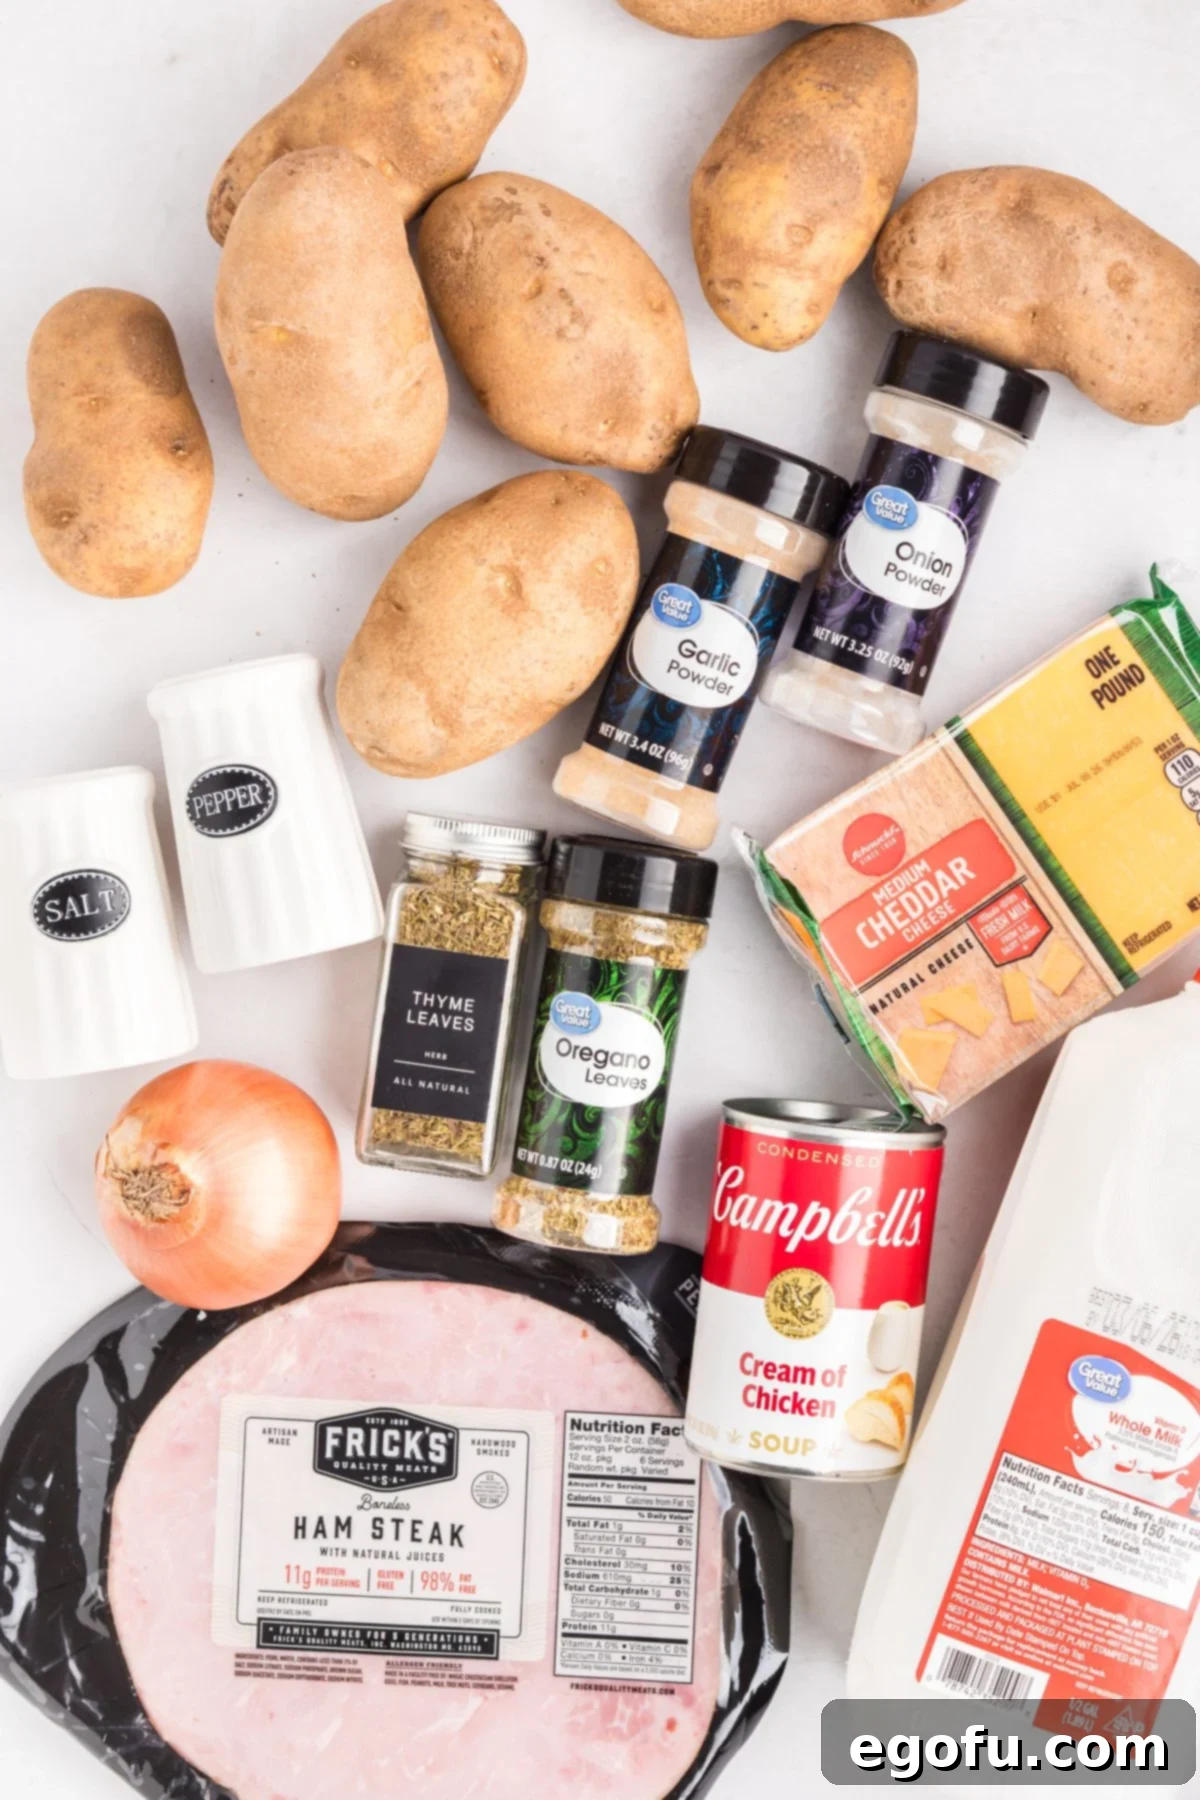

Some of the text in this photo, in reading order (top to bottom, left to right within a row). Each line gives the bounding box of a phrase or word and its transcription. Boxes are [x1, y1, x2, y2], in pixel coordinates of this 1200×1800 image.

[871, 492, 909, 515] Great
[876, 506, 905, 524] Value
[896, 541, 953, 578] Onion
[884, 562, 946, 597] Powder
[658, 590, 693, 613] Great
[662, 604, 690, 622] Value
[678, 639, 741, 677] Garlic
[813, 626, 914, 675] NET WT 3.25 OZ (92g)
[1085, 645, 1120, 679] ONE
[667, 659, 733, 696] Powder
[1091, 663, 1145, 710] POUND
[599, 722, 694, 771] NET WT 3.4 OZ (96g)
[1154, 742, 1167, 755] PER
[1159, 742, 1185, 761] SERVING
[1171, 754, 1194, 776] 110
[193, 783, 263, 818] PEPPER
[872, 859, 931, 906] MEDIUM
[44, 889, 114, 922] SALT
[856, 857, 976, 949] CHEDDAR
[902, 900, 956, 943] CHEESE
[980, 913, 1010, 939] FRESH
[1008, 899, 1032, 921] MILK
[869, 938, 974, 1015] NATURAL CHEESE
[412, 990, 475, 1013] THYME
[556, 999, 591, 1018] Great
[406, 1010, 475, 1032] LEAVES
[561, 1012, 590, 1029] Value
[424, 1050, 448, 1060] HERB
[556, 1037, 650, 1070] Oregano
[393, 1076, 471, 1095] ALL NATURAL
[585, 1069, 648, 1091] Leaves
[517, 1146, 602, 1179] NET WT 0.87 OZ (24g)
[758, 1142, 881, 1169] CONDENSED
[712, 1162, 926, 1252] Campbell's
[739, 1352, 847, 1388] Cream of
[1078, 1361, 1122, 1388] Great
[1085, 1379, 1118, 1397] Value
[742, 1384, 836, 1418] Chicken
[262, 1427, 298, 1436] ARTISAN
[570, 1418, 644, 1434] Nutrition
[1109, 1411, 1181, 1446] Whole Milk
[268, 1438, 291, 1446] MADE
[324, 1426, 447, 1464] FRICK'S
[471, 1438, 516, 1448] HARDWOOD
[569, 1433, 622, 1442] Serving Size
[748, 1431, 816, 1455] SOUP
[477, 1448, 510, 1457] SMOKED
[568, 1443, 665, 1455] Servings Per Container
[333, 1461, 438, 1474] QUALITY MEATS
[568, 1462, 668, 1476] Random Varied
[596, 1455, 612, 1463] pkg
[648, 1457, 684, 1468] Servings
[617, 1483, 648, 1491] Serving
[1002, 1457, 1178, 1529] Nutrition Facts Serv. size:
[357, 1493, 411, 1511] Boneless
[567, 1494, 602, 1502] Calories
[566, 1519, 609, 1529] Total Fat
[983, 1514, 1008, 1529] Protein
[1022, 1506, 1049, 1522] Sodium
[1102, 1535, 1121, 1548] Total
[1101, 1510, 1138, 1530] Calories
[293, 1516, 465, 1548] HAM STEAK
[573, 1532, 616, 1542] Saturated
[320, 1547, 445, 1562] WITH NATURAL JUICES
[564, 1558, 621, 1568] Cholesterol
[285, 1564, 311, 1589] 11g
[316, 1567, 345, 1575] PROTEIN
[377, 1570, 404, 1579] GLUTEN
[459, 1574, 472, 1582] FAT
[564, 1570, 600, 1579] Sodium
[964, 1559, 1065, 1602] DISTRIBUTED Walmart
[316, 1578, 360, 1588] PER SERVING
[377, 1581, 395, 1590] FREE
[420, 1571, 455, 1592] 98%
[459, 1585, 476, 1594] FREE
[564, 1583, 649, 1595] Total Carbohydrate
[278, 1598, 328, 1606] REFRIGERATED
[571, 1596, 601, 1606] Dietary
[570, 1609, 600, 1619] Sugars
[279, 1626, 478, 1644] FAMILY OWNED FOR GENERATIONS
[562, 1622, 598, 1631] Protein
[306, 1637, 337, 1645] QUALITY
